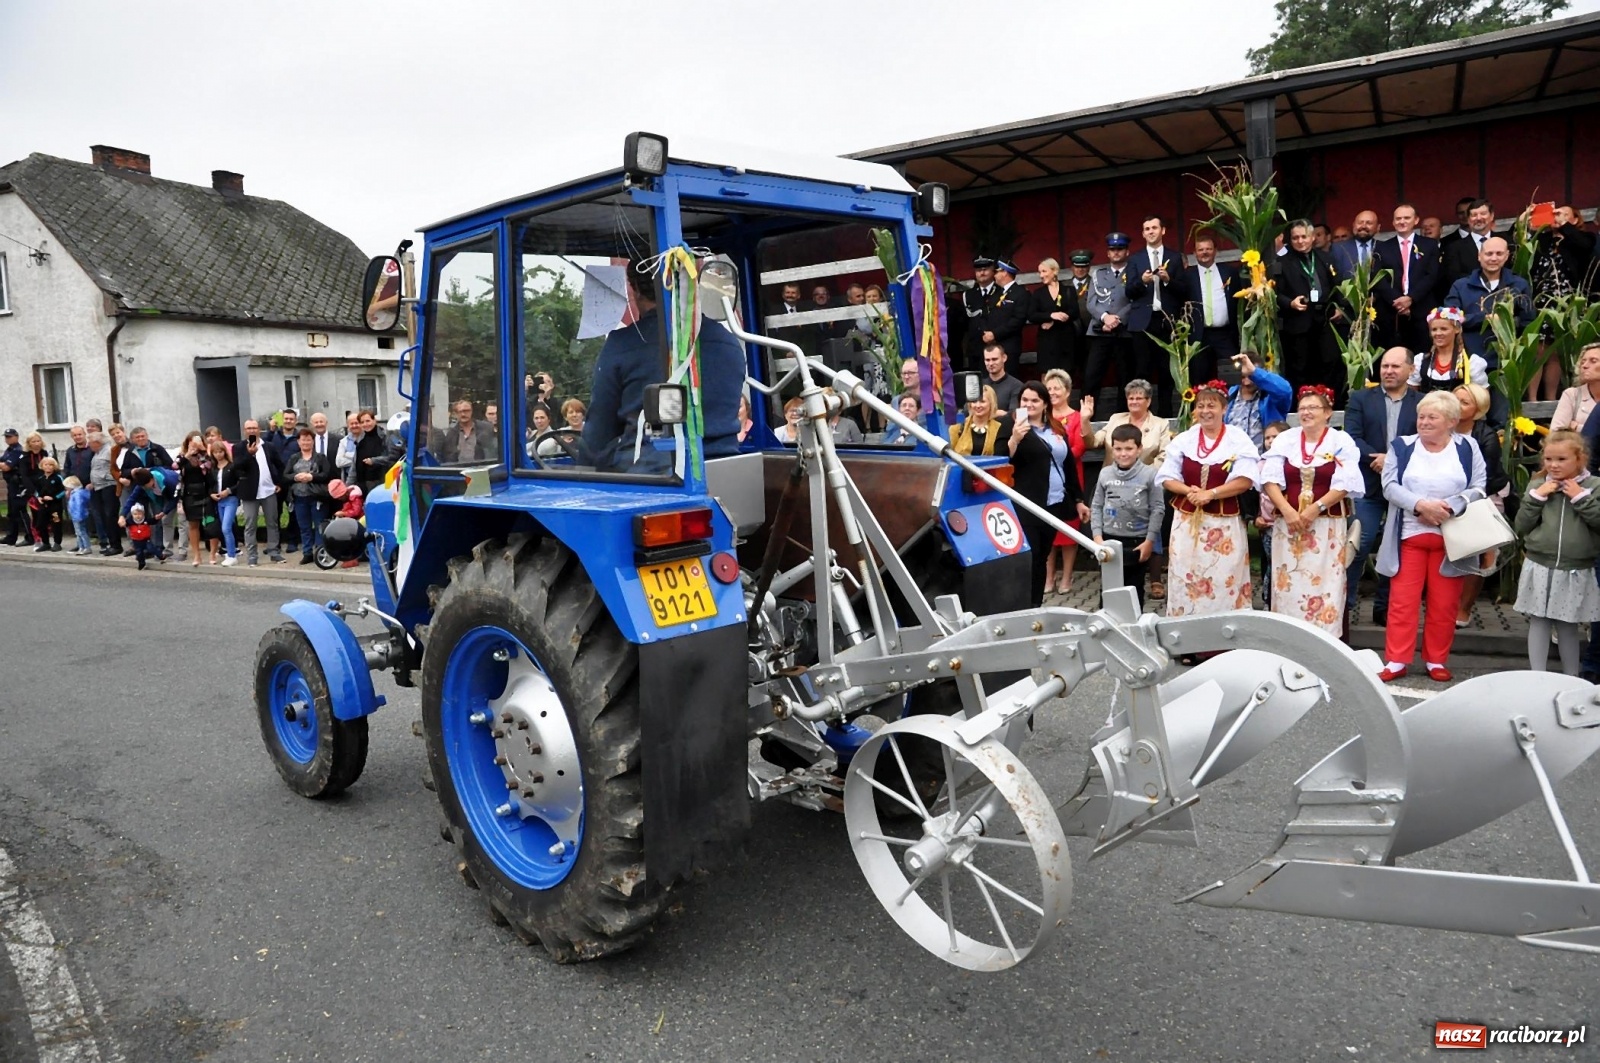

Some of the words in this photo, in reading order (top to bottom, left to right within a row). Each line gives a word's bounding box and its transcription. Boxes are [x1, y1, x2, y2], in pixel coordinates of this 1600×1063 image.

[988, 512, 1012, 537] 25
[650, 564, 690, 591] T01
[653, 590, 705, 620] 9121
